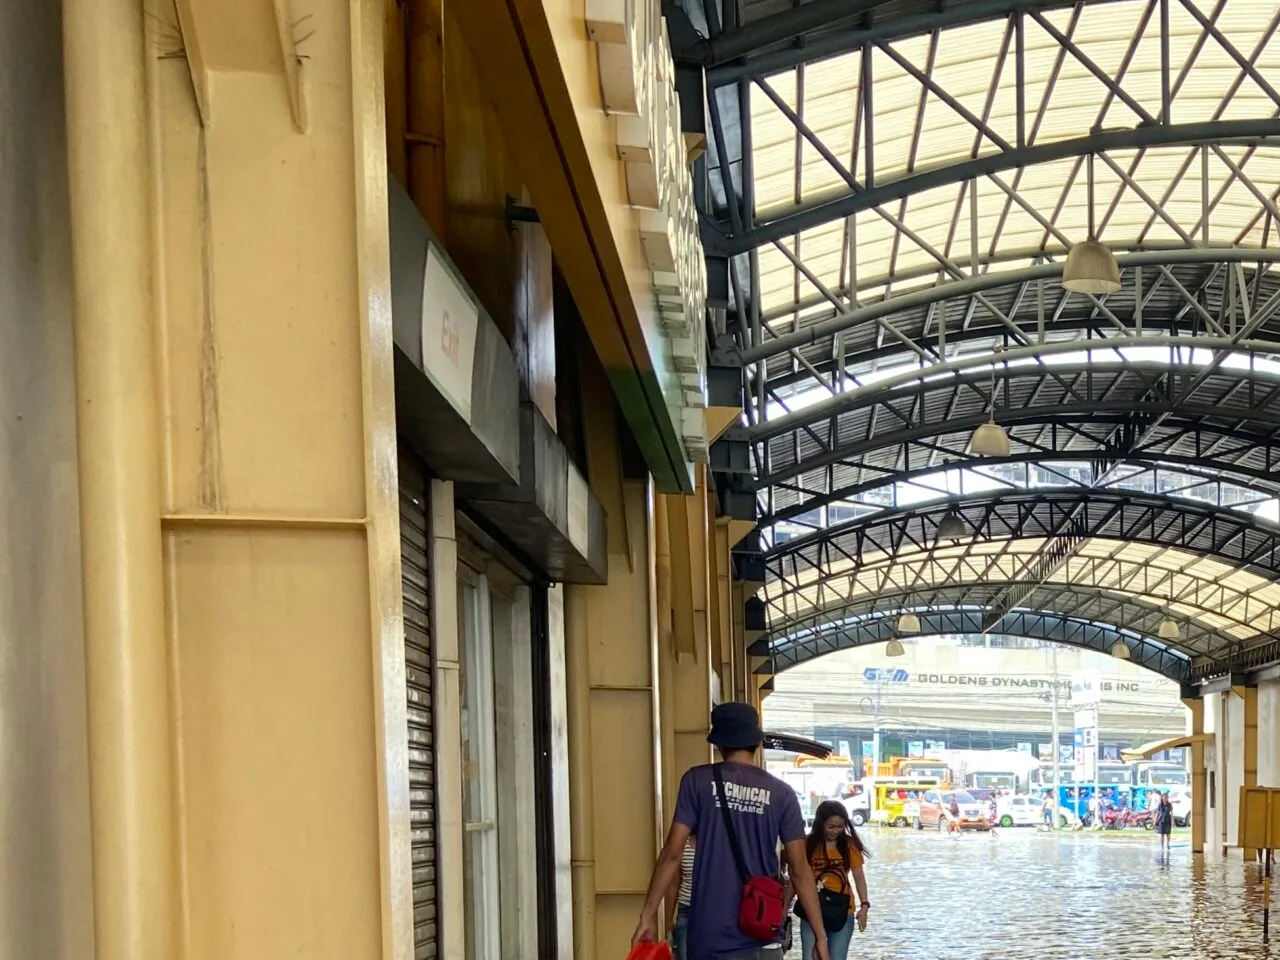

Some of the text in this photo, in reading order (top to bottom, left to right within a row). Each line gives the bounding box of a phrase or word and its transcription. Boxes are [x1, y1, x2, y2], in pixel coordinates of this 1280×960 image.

[918, 673, 987, 686] GOLDENS
[1116, 682, 1139, 691] INC
[711, 781, 770, 805] TCHNICAL
